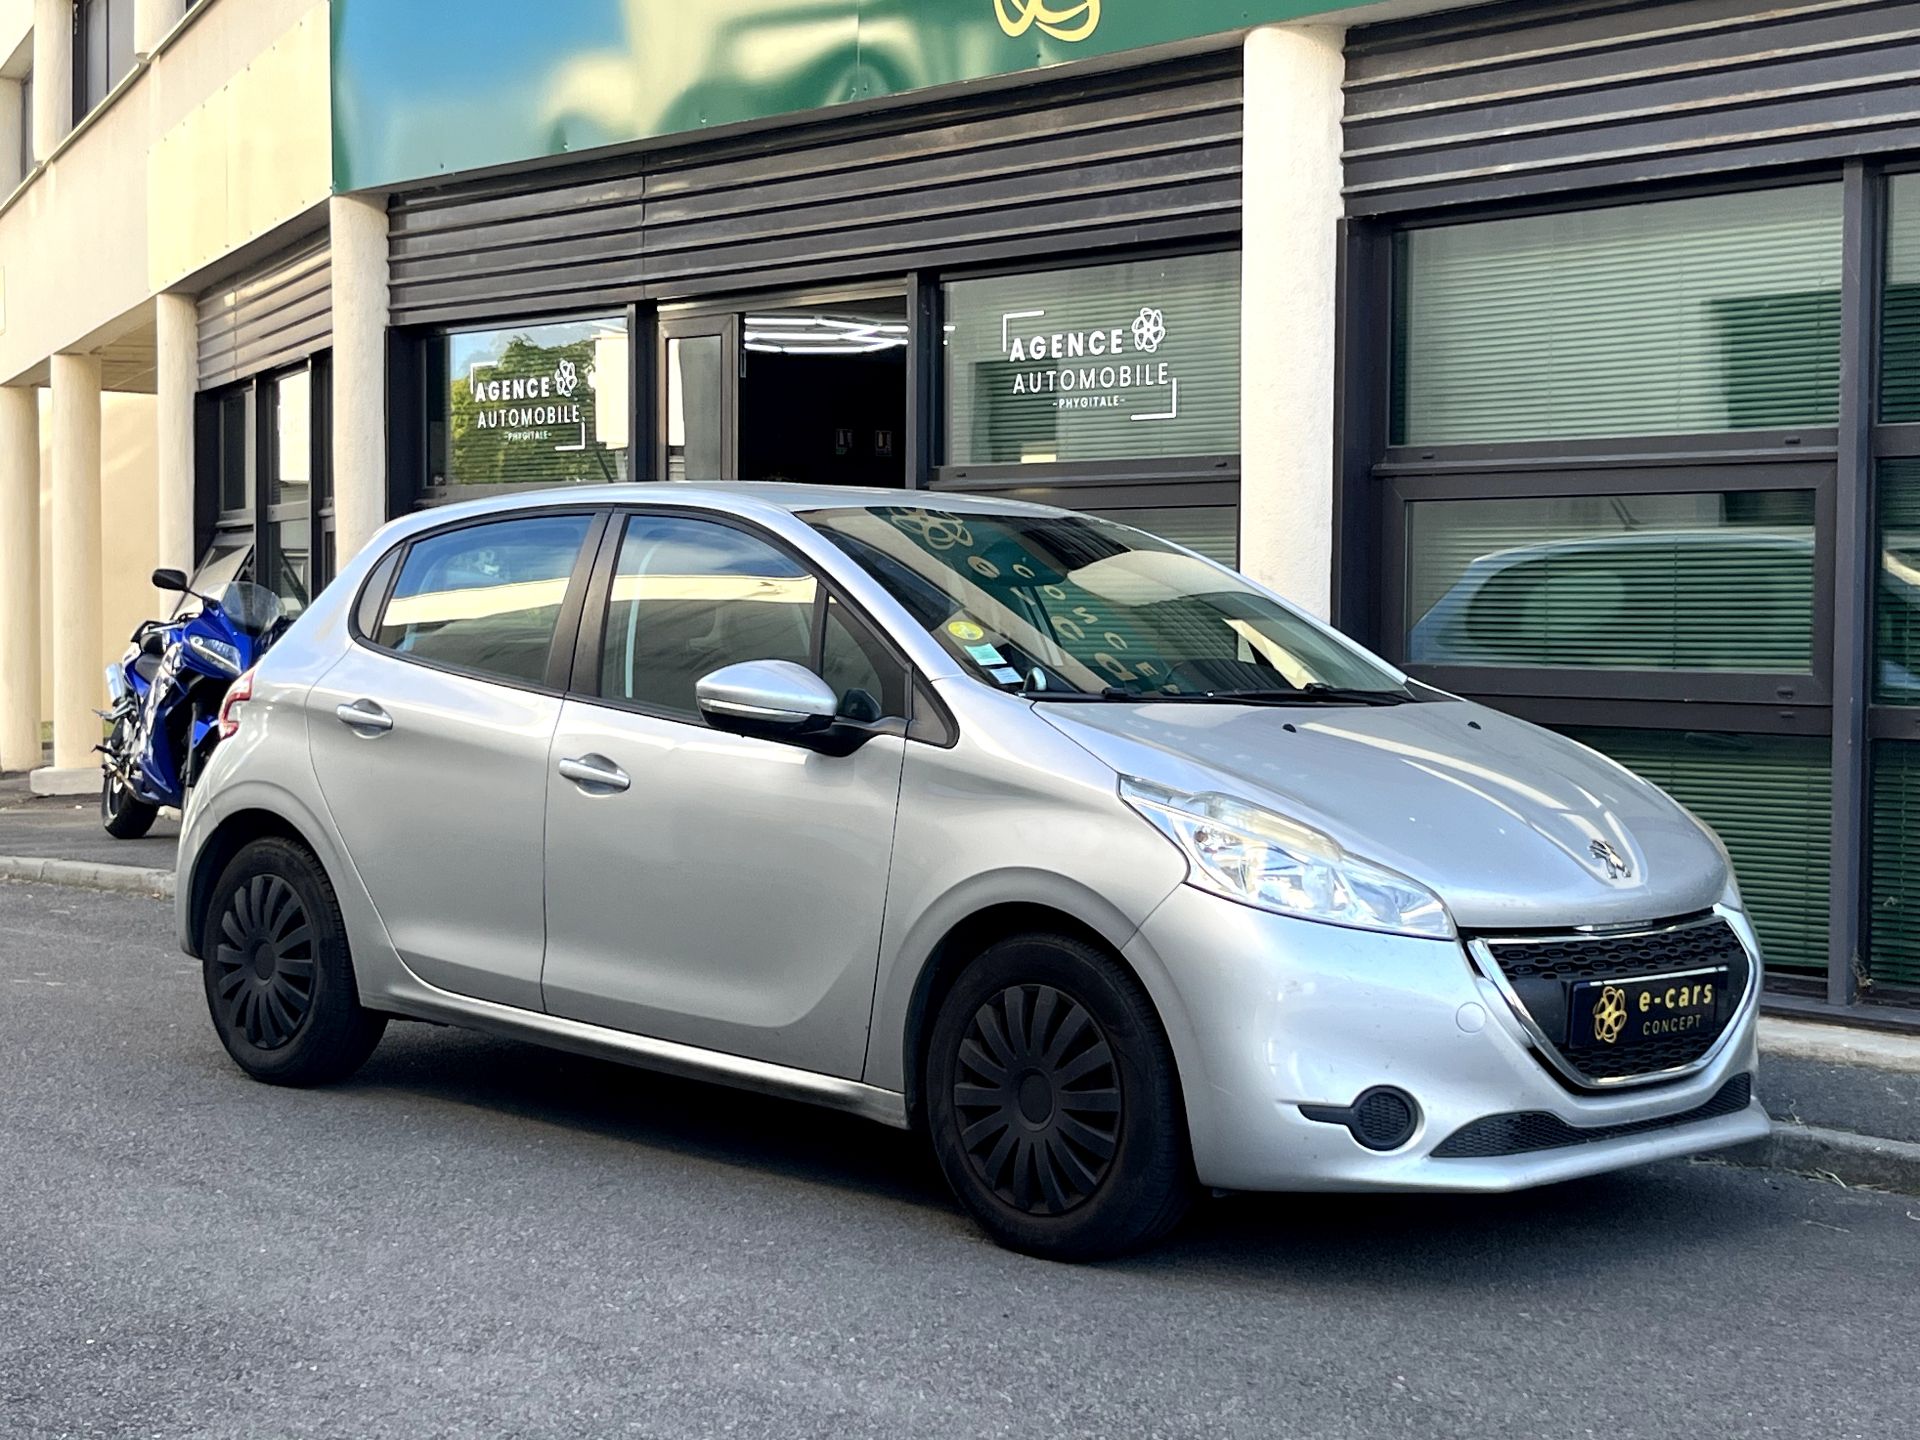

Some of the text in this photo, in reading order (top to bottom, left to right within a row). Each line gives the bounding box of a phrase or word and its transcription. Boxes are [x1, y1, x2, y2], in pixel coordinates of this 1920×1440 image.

[1009, 328, 1123, 362] AGENCE
[474, 376, 550, 403] AGENCE
[1012, 362, 1169, 394] AUTOMOBILE
[477, 404, 580, 428] AUTOMOBILE
[1638, 983, 1713, 1012] e-cars
[1642, 1014, 1701, 1036] CONCEPT
